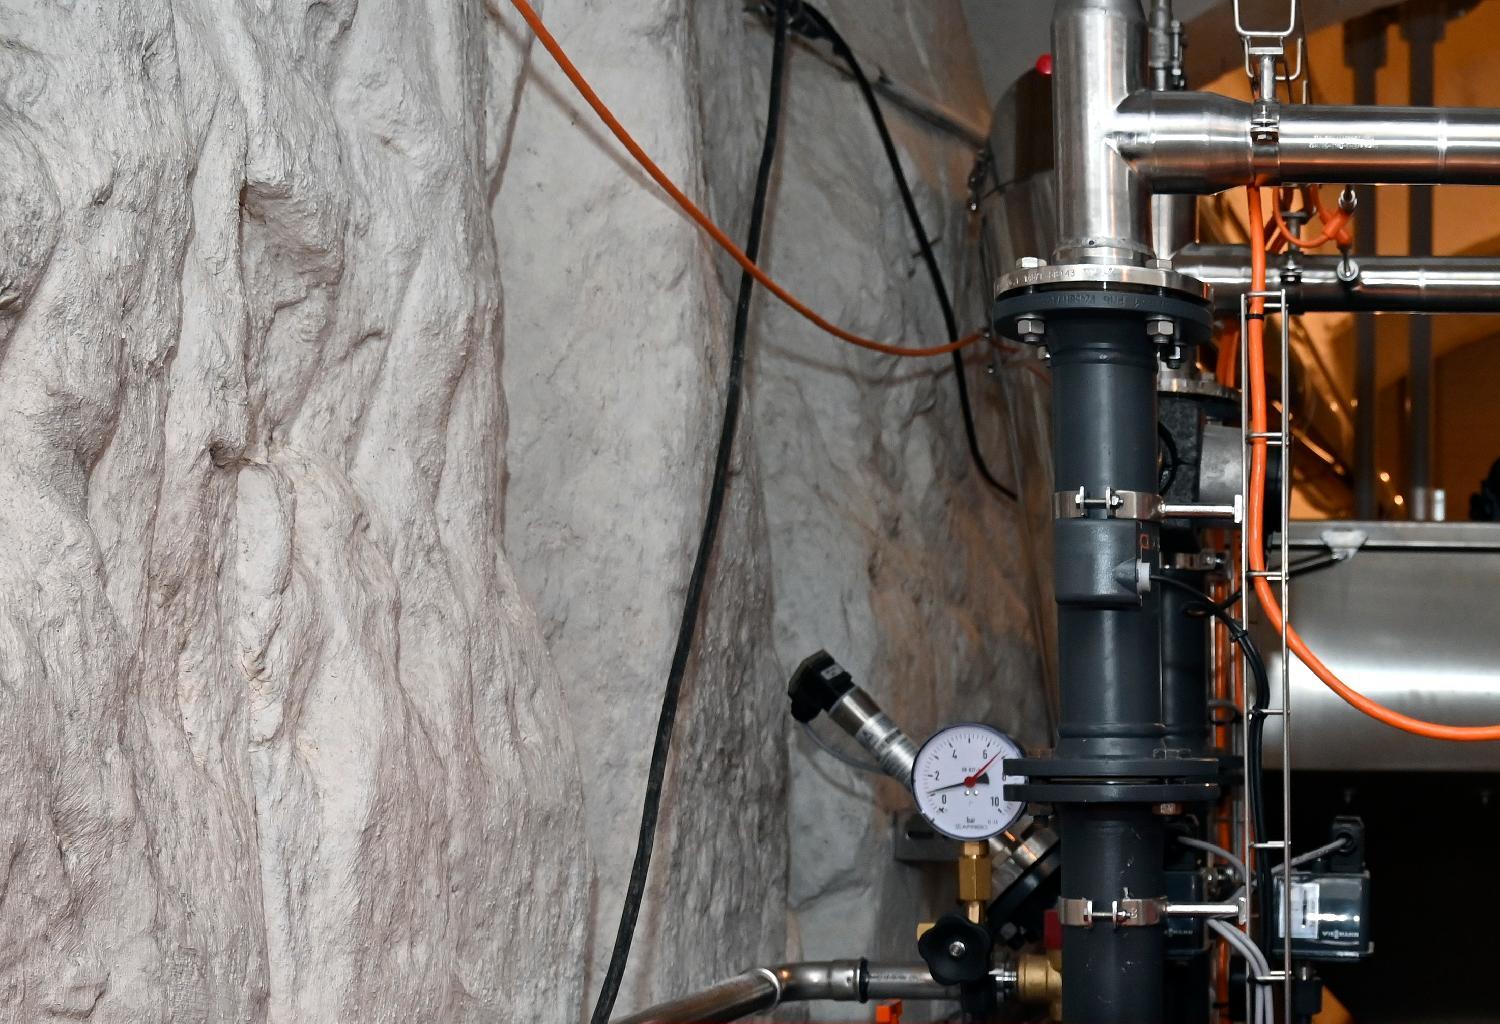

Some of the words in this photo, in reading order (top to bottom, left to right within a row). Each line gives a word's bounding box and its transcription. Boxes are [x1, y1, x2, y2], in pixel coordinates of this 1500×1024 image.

[952, 749, 957, 759] 4
[982, 749, 988, 759] 6
[935, 770, 940, 781] 2
[941, 794, 947, 804] 0
[990, 796, 1000, 807] 10
